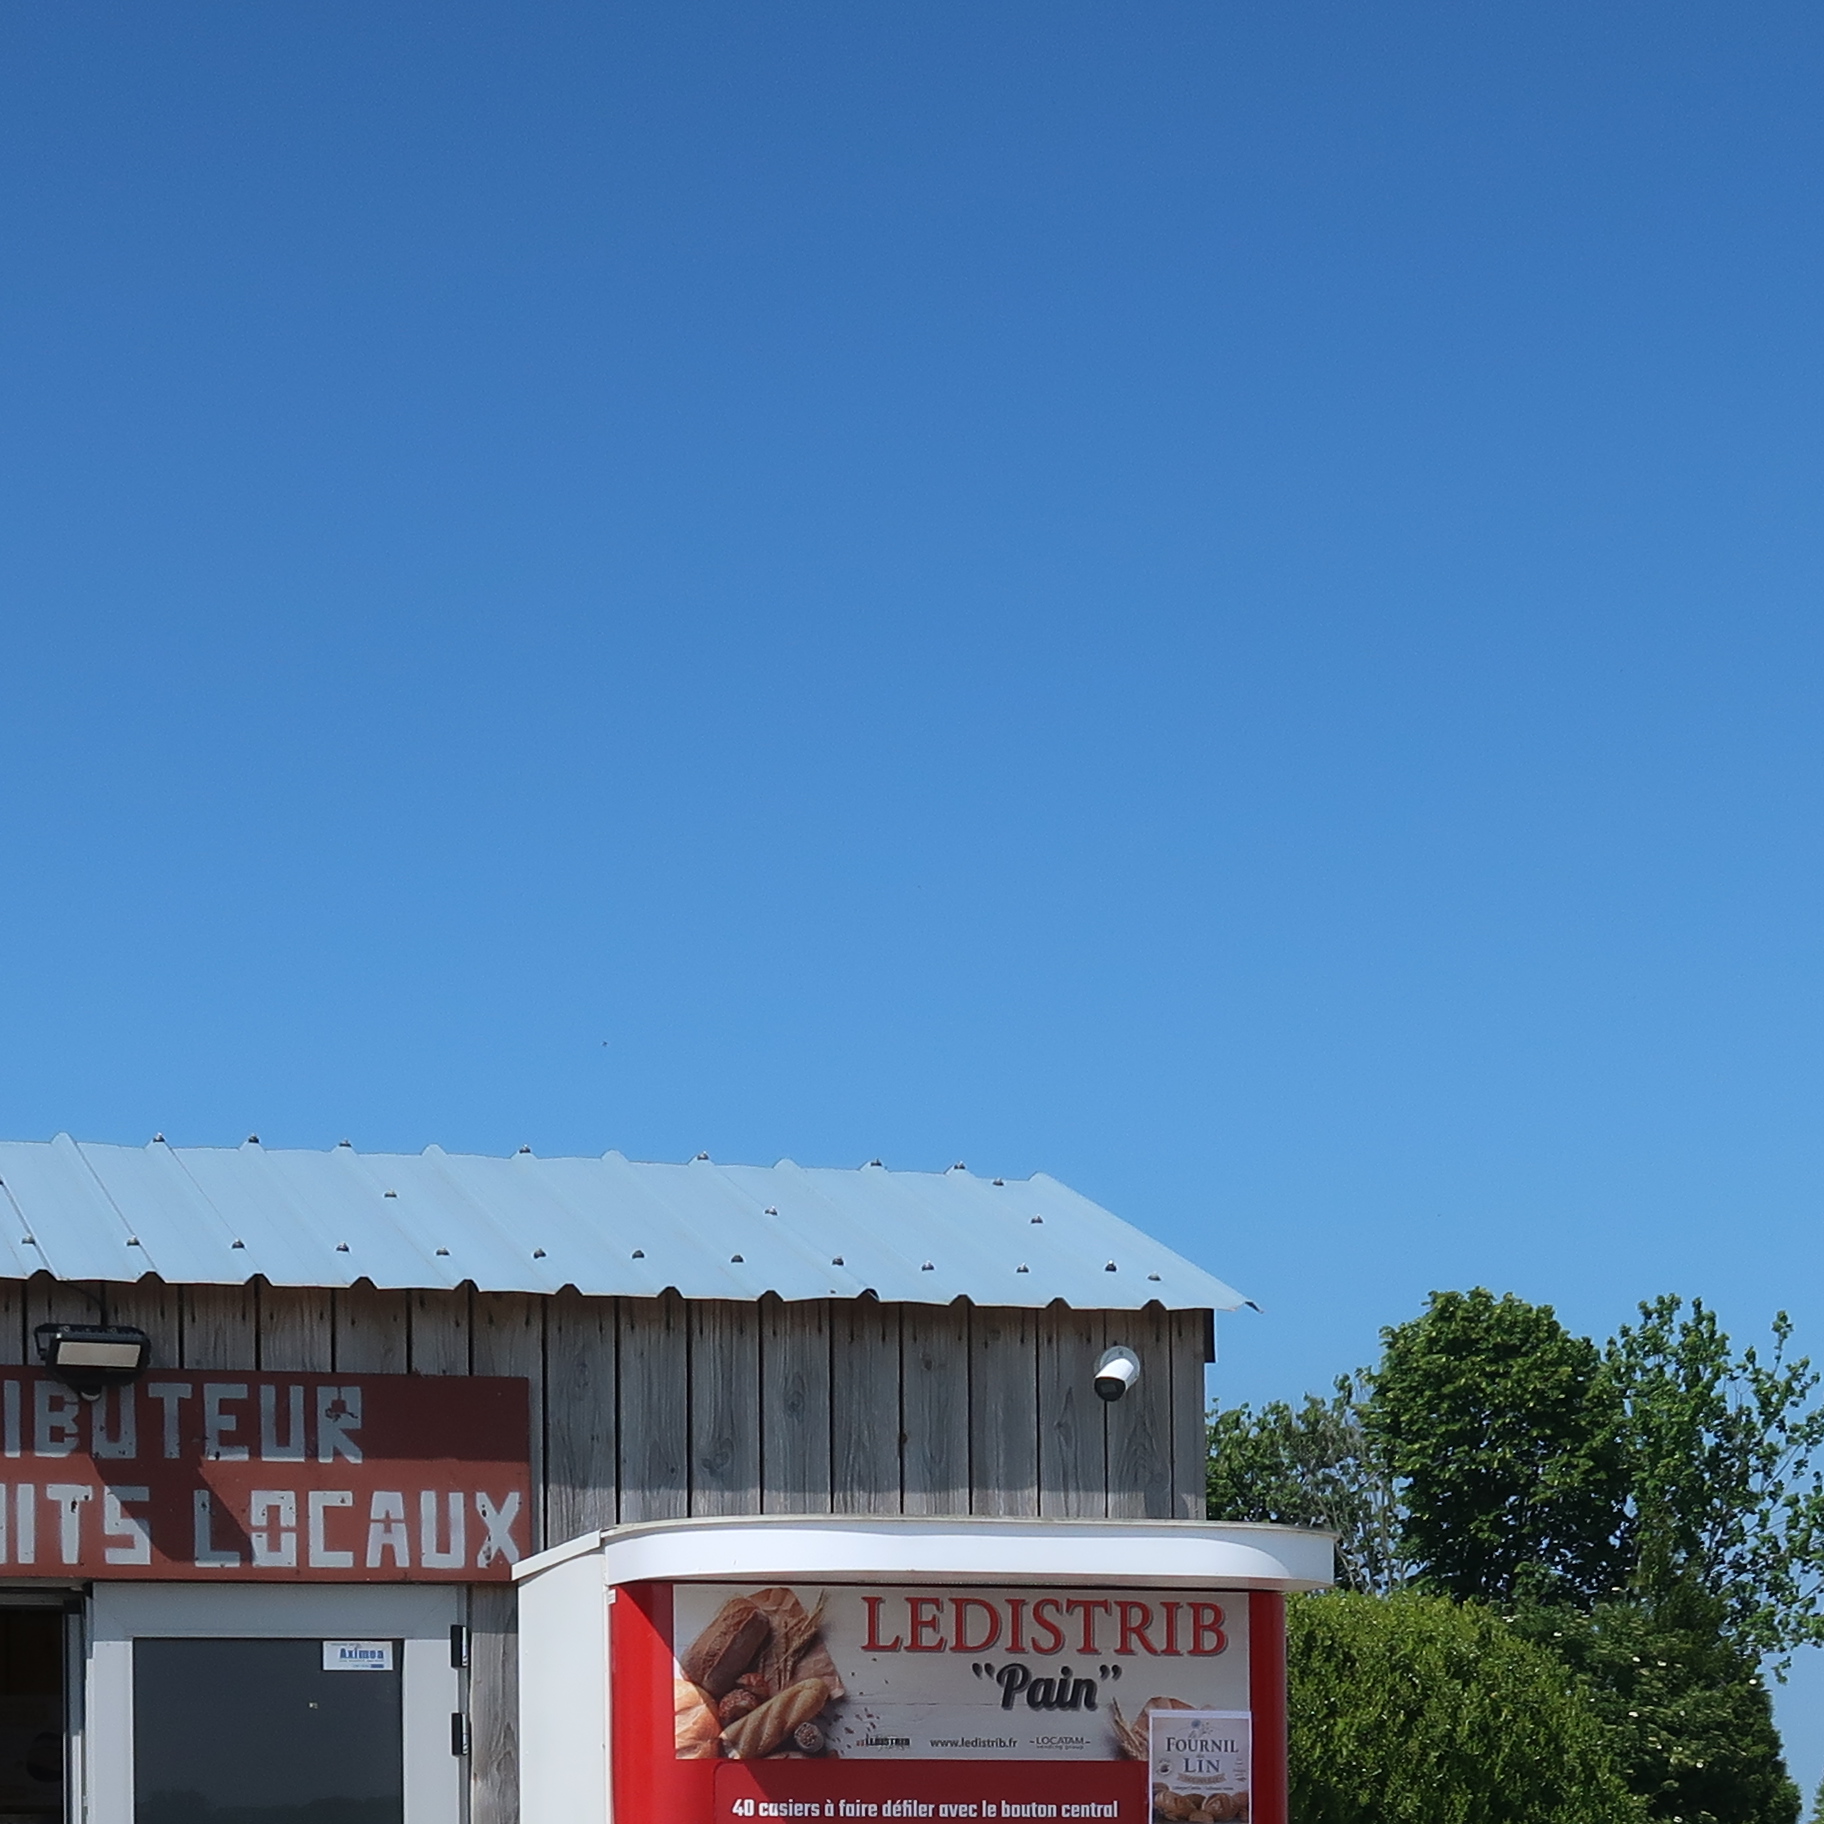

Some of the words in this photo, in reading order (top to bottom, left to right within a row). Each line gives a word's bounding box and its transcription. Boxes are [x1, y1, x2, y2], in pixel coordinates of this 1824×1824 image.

[193, 1489, 521, 1569] LOCAUX
[861, 1596, 1229, 1656] LEDISTRIB
[930, 1737, 1018, 1748] www.ledistrib.fr
[1166, 1737, 1239, 1753] FOURNIL
[1184, 1758, 1220, 1773] LIN
[732, 1798, 755, 1817] 40
[758, 1799, 820, 1817] casiers
[825, 1799, 834, 1817] à
[839, 1800, 877, 1817] faire
[882, 1800, 935, 1817] défiler
[939, 1803, 978, 1818] avec
[982, 1800, 997, 1818] le
[1001, 1800, 1057, 1818] bouton
[1061, 1800, 1118, 1818] central
